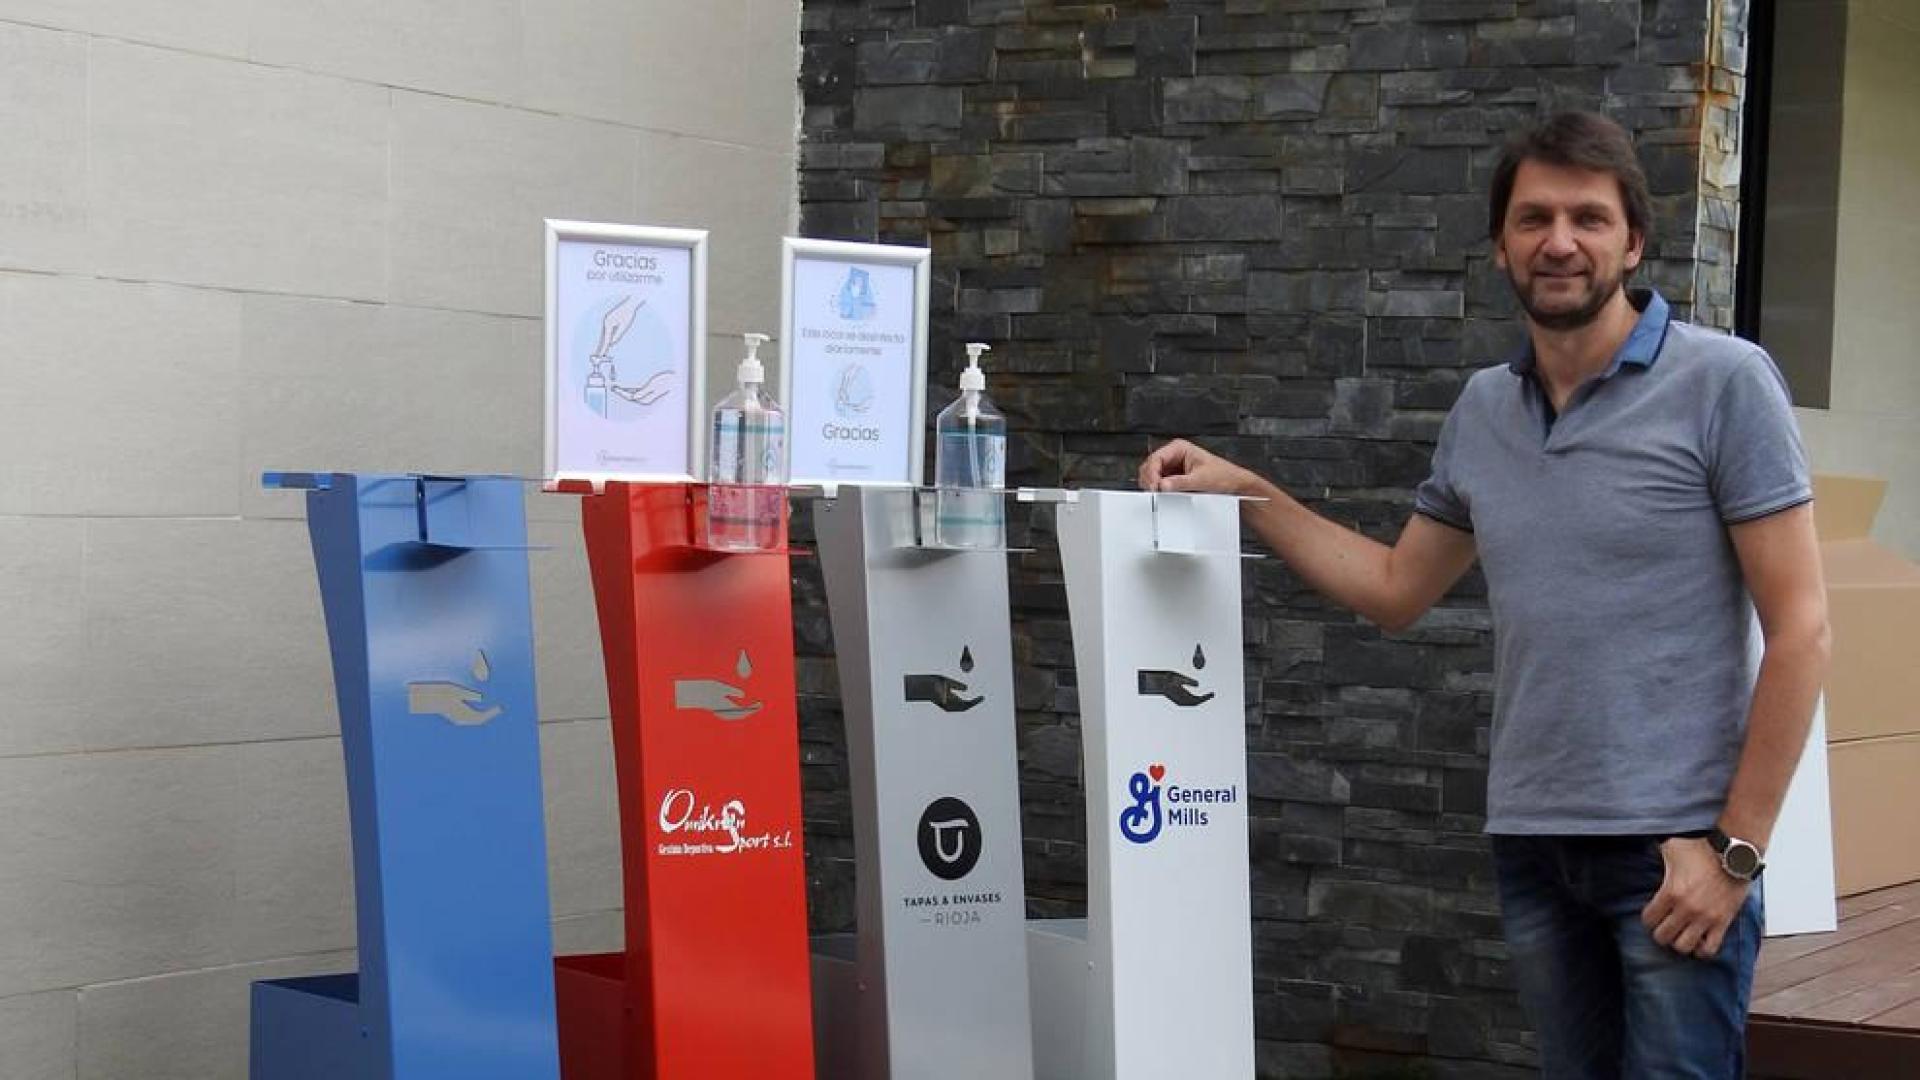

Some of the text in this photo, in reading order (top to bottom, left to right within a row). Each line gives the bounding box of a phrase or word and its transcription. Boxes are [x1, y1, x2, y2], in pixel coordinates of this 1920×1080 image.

[592, 249, 657, 271] Gracias
[823, 423, 880, 441] Gracias
[1168, 785, 1236, 803] General
[1168, 807, 1209, 826] Mills
[904, 892, 1001, 908] TAPAS & ENVASES
[935, 910, 981, 926] RIOJA
